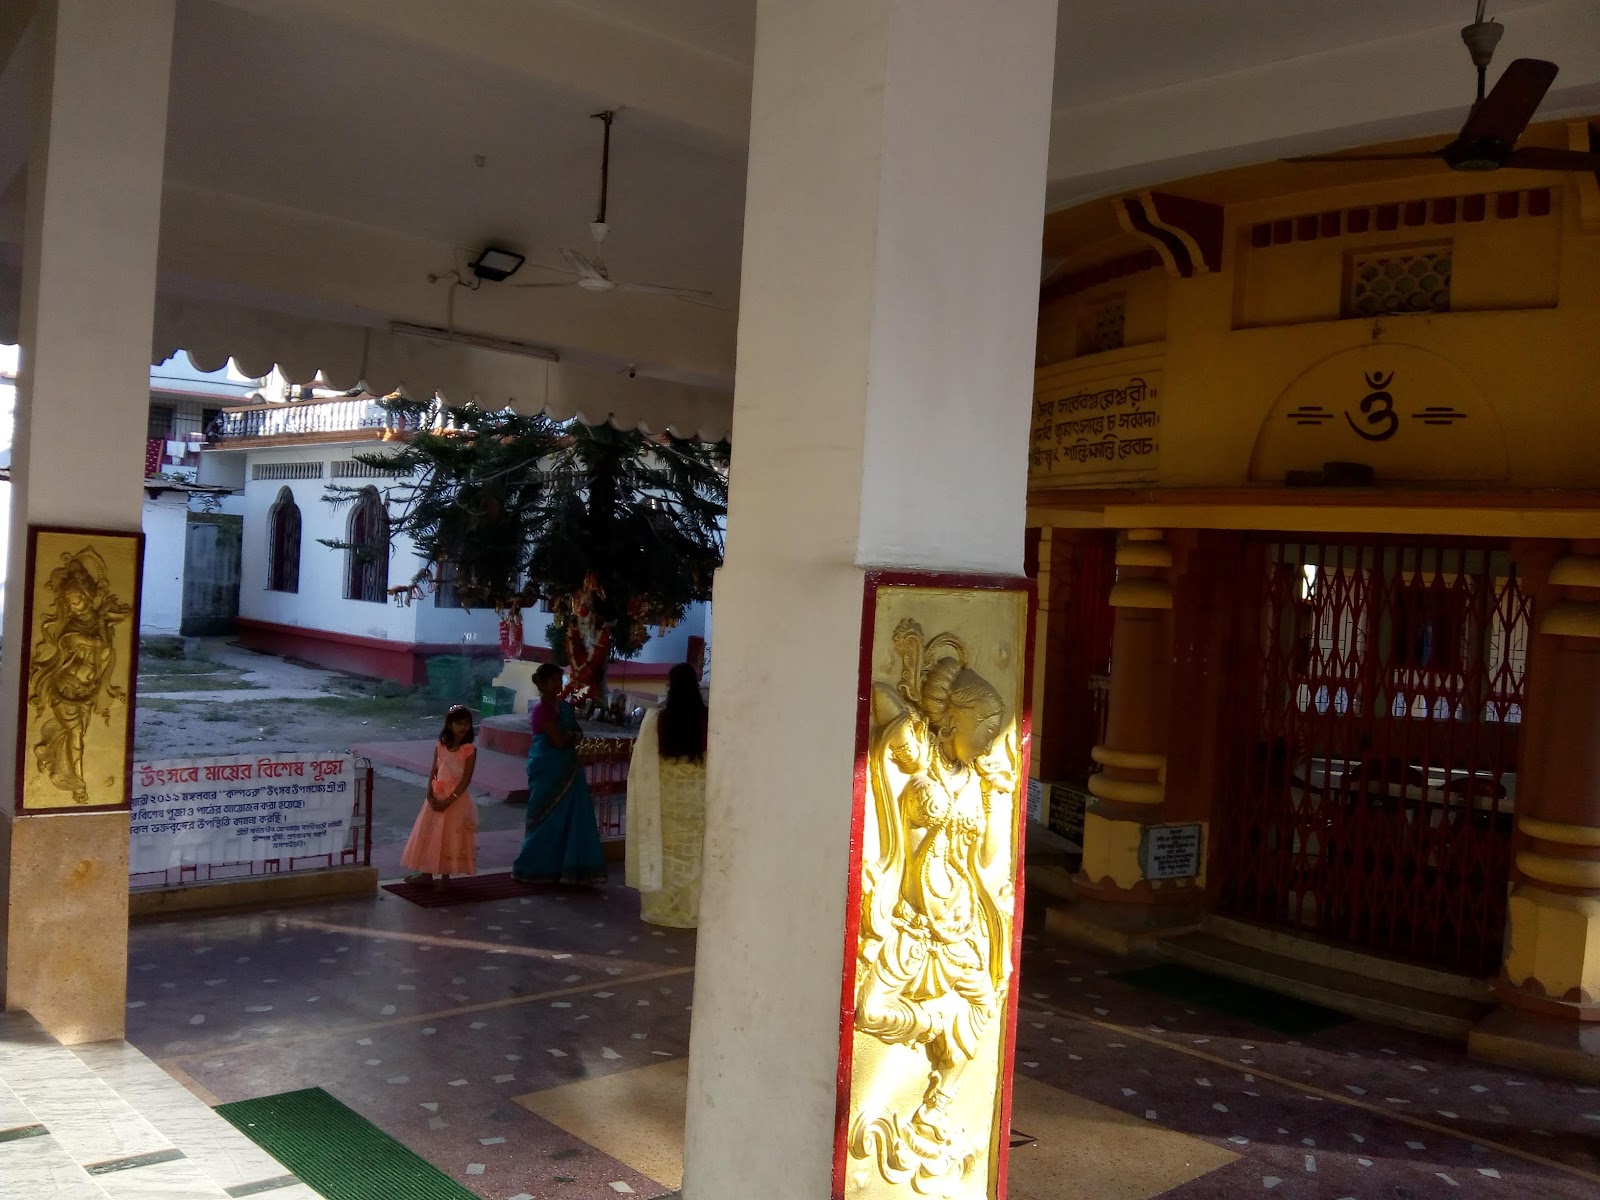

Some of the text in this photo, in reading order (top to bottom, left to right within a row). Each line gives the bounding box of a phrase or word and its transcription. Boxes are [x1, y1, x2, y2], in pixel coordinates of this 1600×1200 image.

[1106, 415, 1116, 431] চ
[139, 757, 344, 788] উৎসবে মায়ের বিশেষ পূজা
[150, 793, 180, 804] ২০১৯
[181, 790, 217, 802] মঙ্গলবার
[266, 784, 291, 797] উৎসব
[138, 808, 165, 820] বিশেষ
[166, 808, 186, 821] পূজা
[187, 807, 195, 816] ও
[196, 804, 221, 815] পাঠের
[223, 802, 259, 814] আয়োজন
[260, 800, 276, 810] করা
[197, 816, 231, 830] উপস্থিতি
[233, 816, 256, 827] কামনা
[259, 812, 282, 824] করছি
